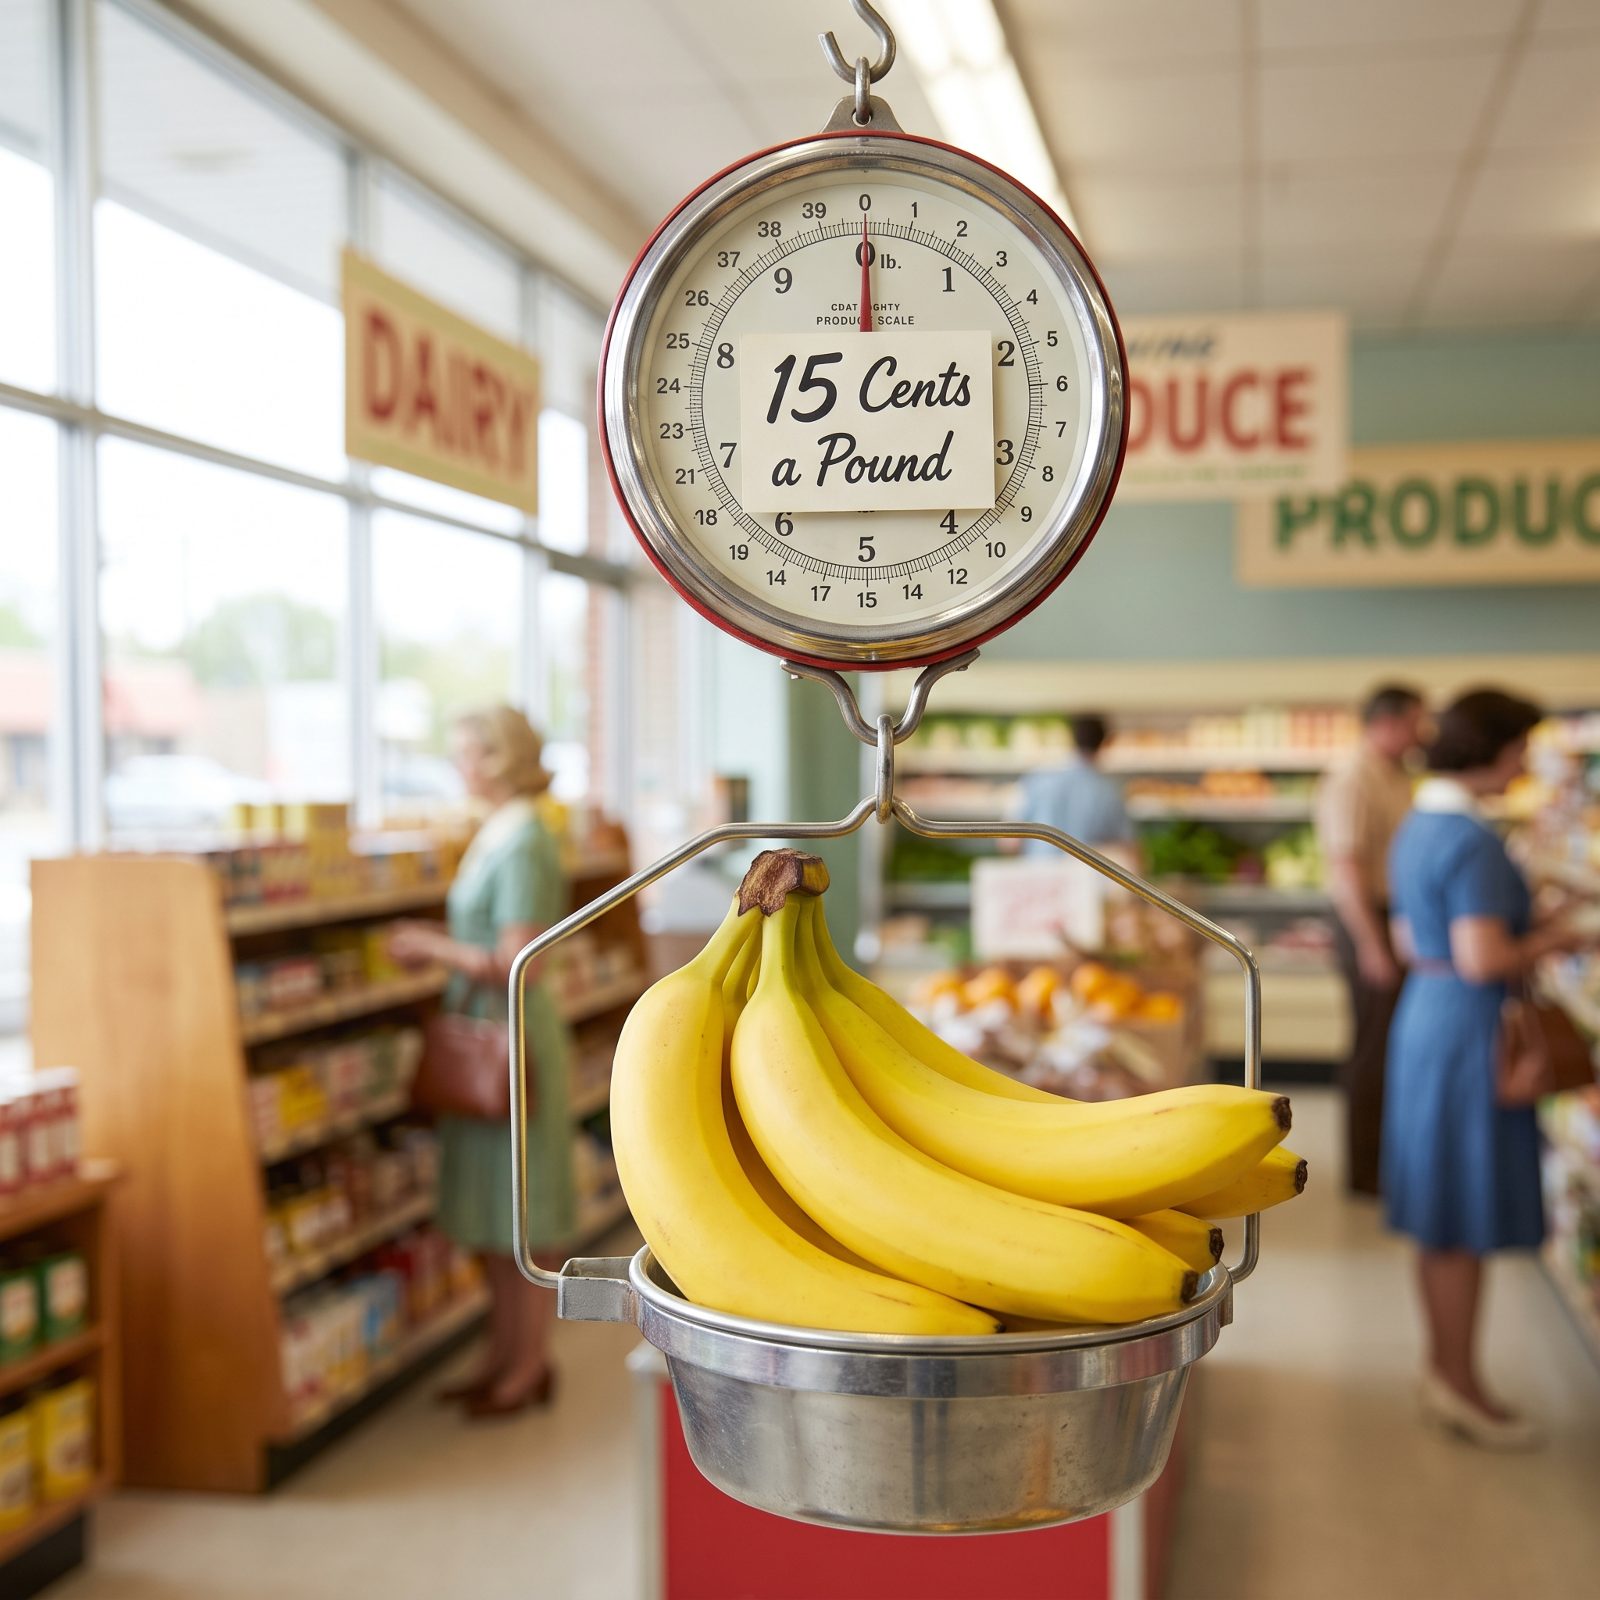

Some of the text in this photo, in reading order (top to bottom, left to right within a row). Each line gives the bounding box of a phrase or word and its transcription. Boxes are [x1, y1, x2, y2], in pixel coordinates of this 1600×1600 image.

[802, 202, 827, 219] 39
[859, 193, 872, 211] 0
[911, 201, 918, 218] 1
[758, 220, 782, 238] 38
[956, 220, 968, 237] 2
[717, 251, 740, 268] 37
[855, 240, 902, 269] 0 lb.
[996, 250, 1008, 267] 3
[773, 267, 793, 294] 9
[941, 266, 956, 293] 1
[685, 289, 709, 306] 26
[1026, 289, 1039, 305] 4
[816, 315, 915, 326] PRODU SCALE
[666, 333, 690, 350] 25
[1047, 330, 1059, 347] 5
[716, 342, 735, 369] 8
[996, 340, 1016, 367] 2
[656, 377, 681, 394] 24
[766, 352, 971, 424] 15 Cents
[1056, 375, 1069, 392] 6
[362, 303, 535, 482] DAIRY
[659, 422, 684, 439] 23
[1056, 421, 1067, 437] 7
[719, 442, 738, 469] 7
[771, 430, 955, 488] a Pound
[995, 439, 1015, 466] 3
[675, 468, 695, 485] 21
[1042, 466, 1054, 482] 8
[694, 508, 718, 526] 18
[939, 509, 959, 535] 4
[1020, 505, 1033, 522] 9
[774, 512, 794, 537] 6
[729, 543, 749, 560] 19
[857, 535, 876, 563] 5
[985, 541, 1007, 558] 10
[766, 569, 787, 586] 14
[947, 568, 968, 585] 12
[811, 585, 832, 602] 17
[857, 591, 878, 608] 15
[902, 583, 924, 600] 14
